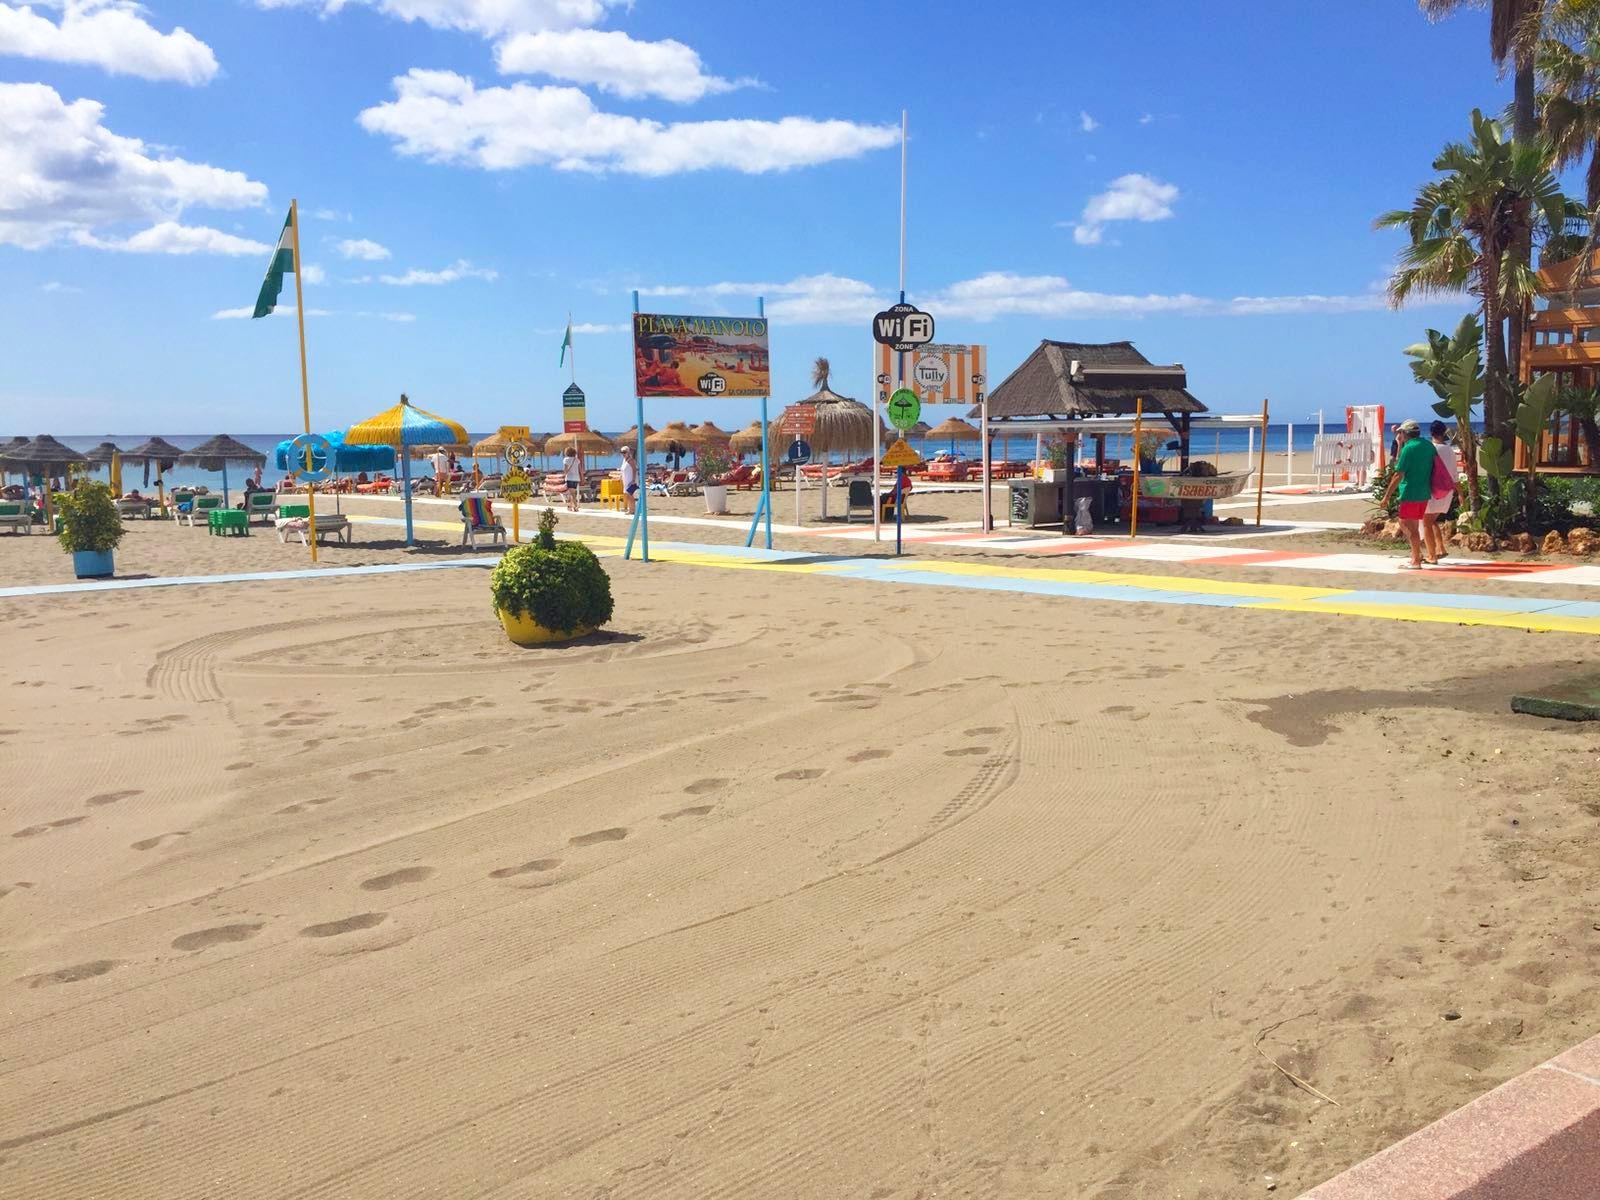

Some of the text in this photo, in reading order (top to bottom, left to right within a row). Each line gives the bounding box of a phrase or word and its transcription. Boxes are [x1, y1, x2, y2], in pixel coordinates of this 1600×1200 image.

[638, 317, 766, 337] PLAYA MANOLO
[878, 318, 928, 337] WiFi
[919, 367, 945, 382] Tully
[700, 379, 724, 391] WiFi
[1178, 484, 1217, 497] ISABEL
